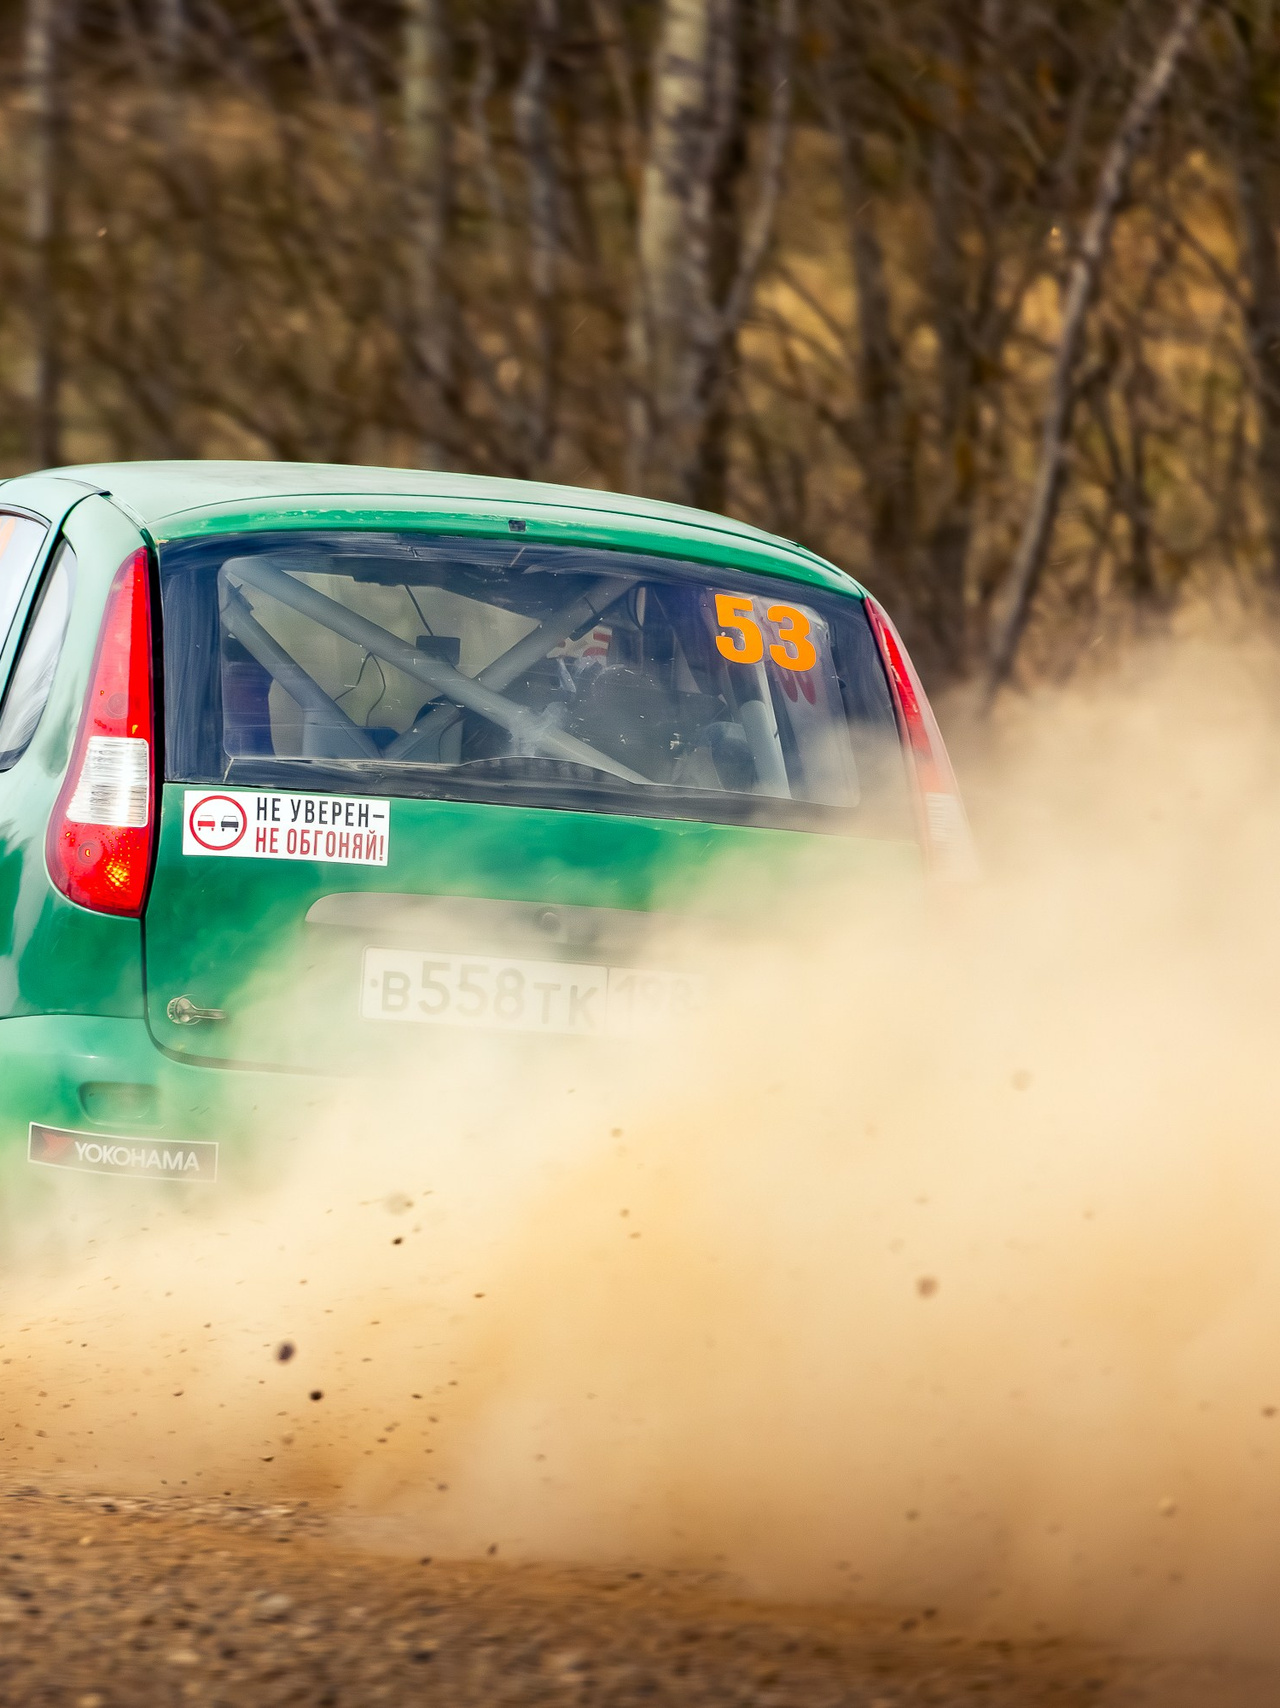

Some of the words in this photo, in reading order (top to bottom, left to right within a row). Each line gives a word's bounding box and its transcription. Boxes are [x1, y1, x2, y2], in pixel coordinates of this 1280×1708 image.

[715, 594, 817, 672] 53
[256, 797, 281, 822] НЕ
[255, 827, 279, 853] НЕ
[286, 828, 385, 861] ОБГОНЯЙ!
[75, 1141, 200, 1171] YOKOHAMA
